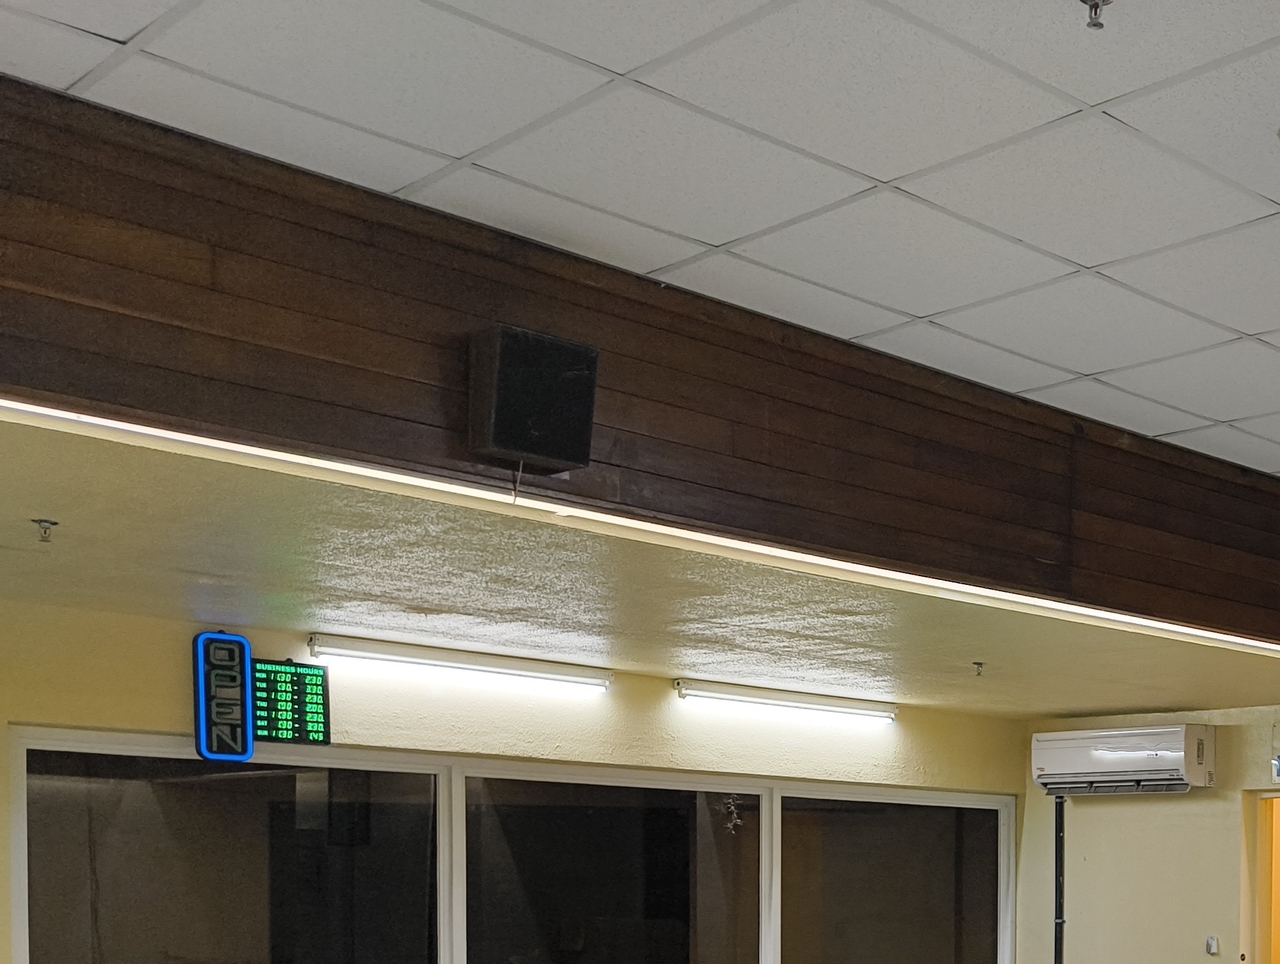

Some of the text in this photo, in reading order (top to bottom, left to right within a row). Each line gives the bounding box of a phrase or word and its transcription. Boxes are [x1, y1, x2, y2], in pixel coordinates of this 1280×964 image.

[209, 643, 242, 751] OPEN
[256, 663, 324, 676] BUSINESS HOURS
